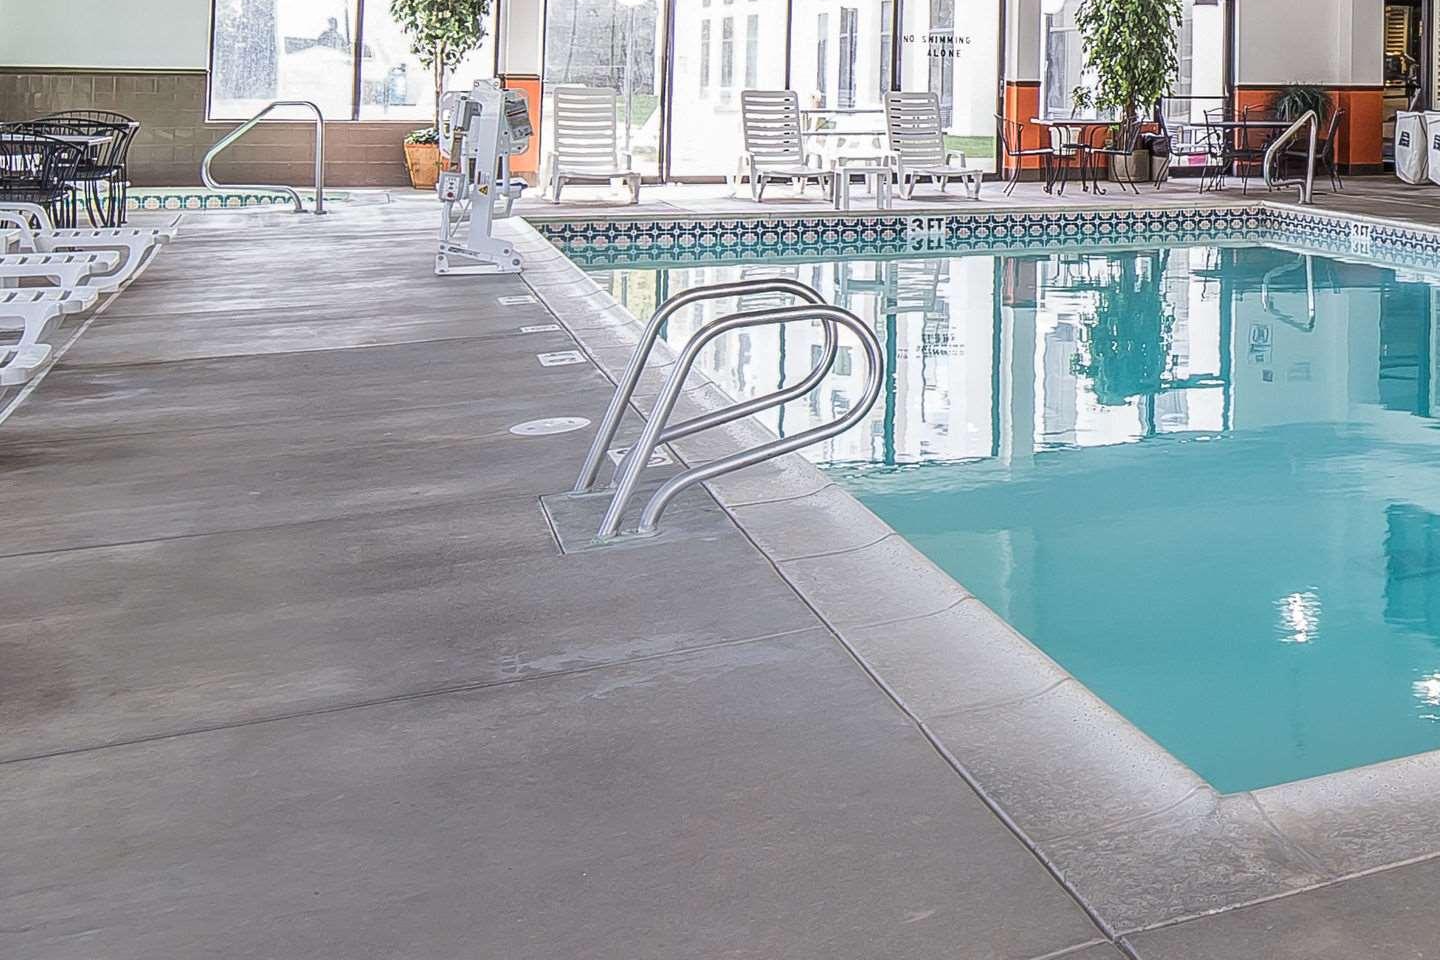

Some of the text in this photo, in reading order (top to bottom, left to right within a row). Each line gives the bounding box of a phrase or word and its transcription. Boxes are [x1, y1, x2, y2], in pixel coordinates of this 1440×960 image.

[903, 35, 971, 44] NO SWIMMING
[927, 49, 961, 58] ALONE
[911, 217, 944, 232] 3 FT
